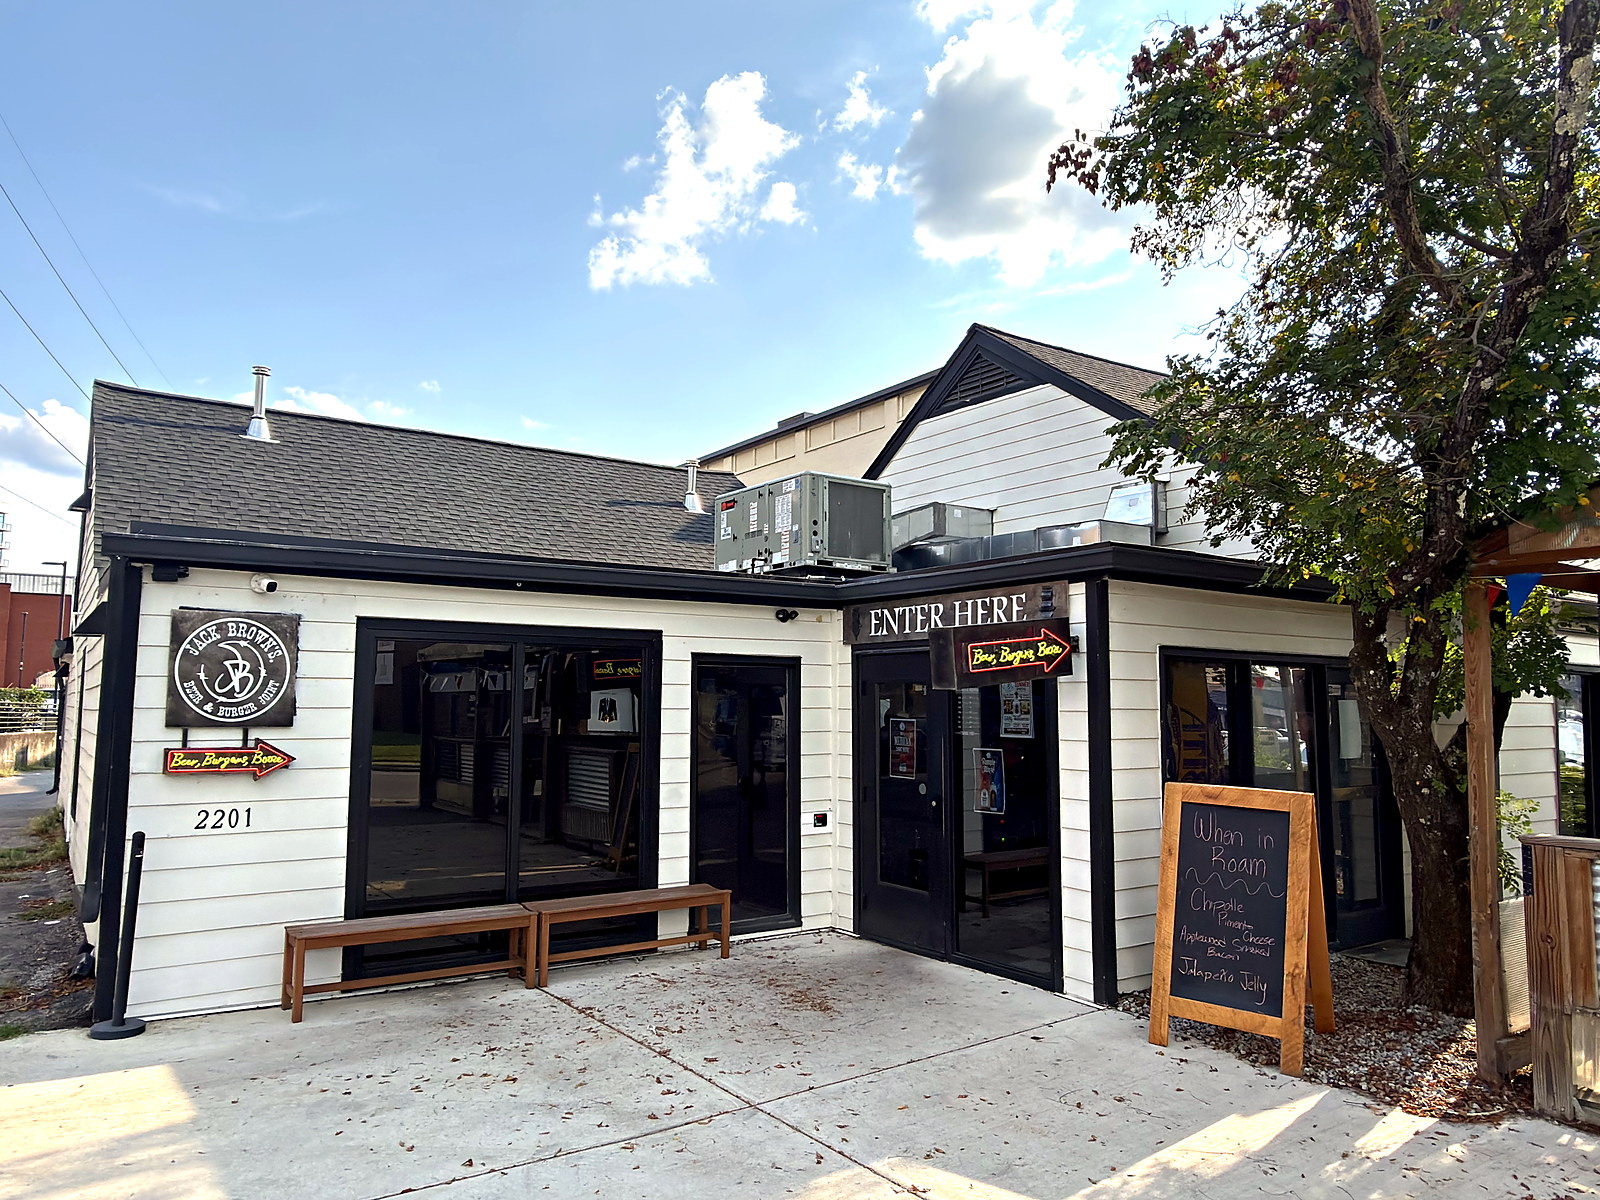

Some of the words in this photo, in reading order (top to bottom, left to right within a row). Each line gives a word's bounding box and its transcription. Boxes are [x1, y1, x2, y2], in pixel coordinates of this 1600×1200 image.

[869, 603, 944, 636] ENTER
[953, 593, 1027, 627] HERE
[185, 626, 221, 656] JACK
[1037, 641, 1063, 656] Booze
[183, 680, 203, 704] BEER
[203, 702, 214, 713] &
[217, 702, 258, 717] BURGER
[258, 680, 280, 705] JOINT
[170, 752, 200, 768] Beer,
[202, 752, 249, 769] Burgers,
[251, 751, 284, 765] Booze
[194, 807, 252, 830] 2201
[1193, 811, 1243, 847] When
[1258, 828, 1275, 849] in
[1211, 846, 1267, 878] Roam
[1242, 930, 1275, 945] Cheese
[1207, 947, 1240, 960] Bacon
[1178, 956, 1234, 983] Jalapeño
[1240, 971, 1267, 1006] Jelly
